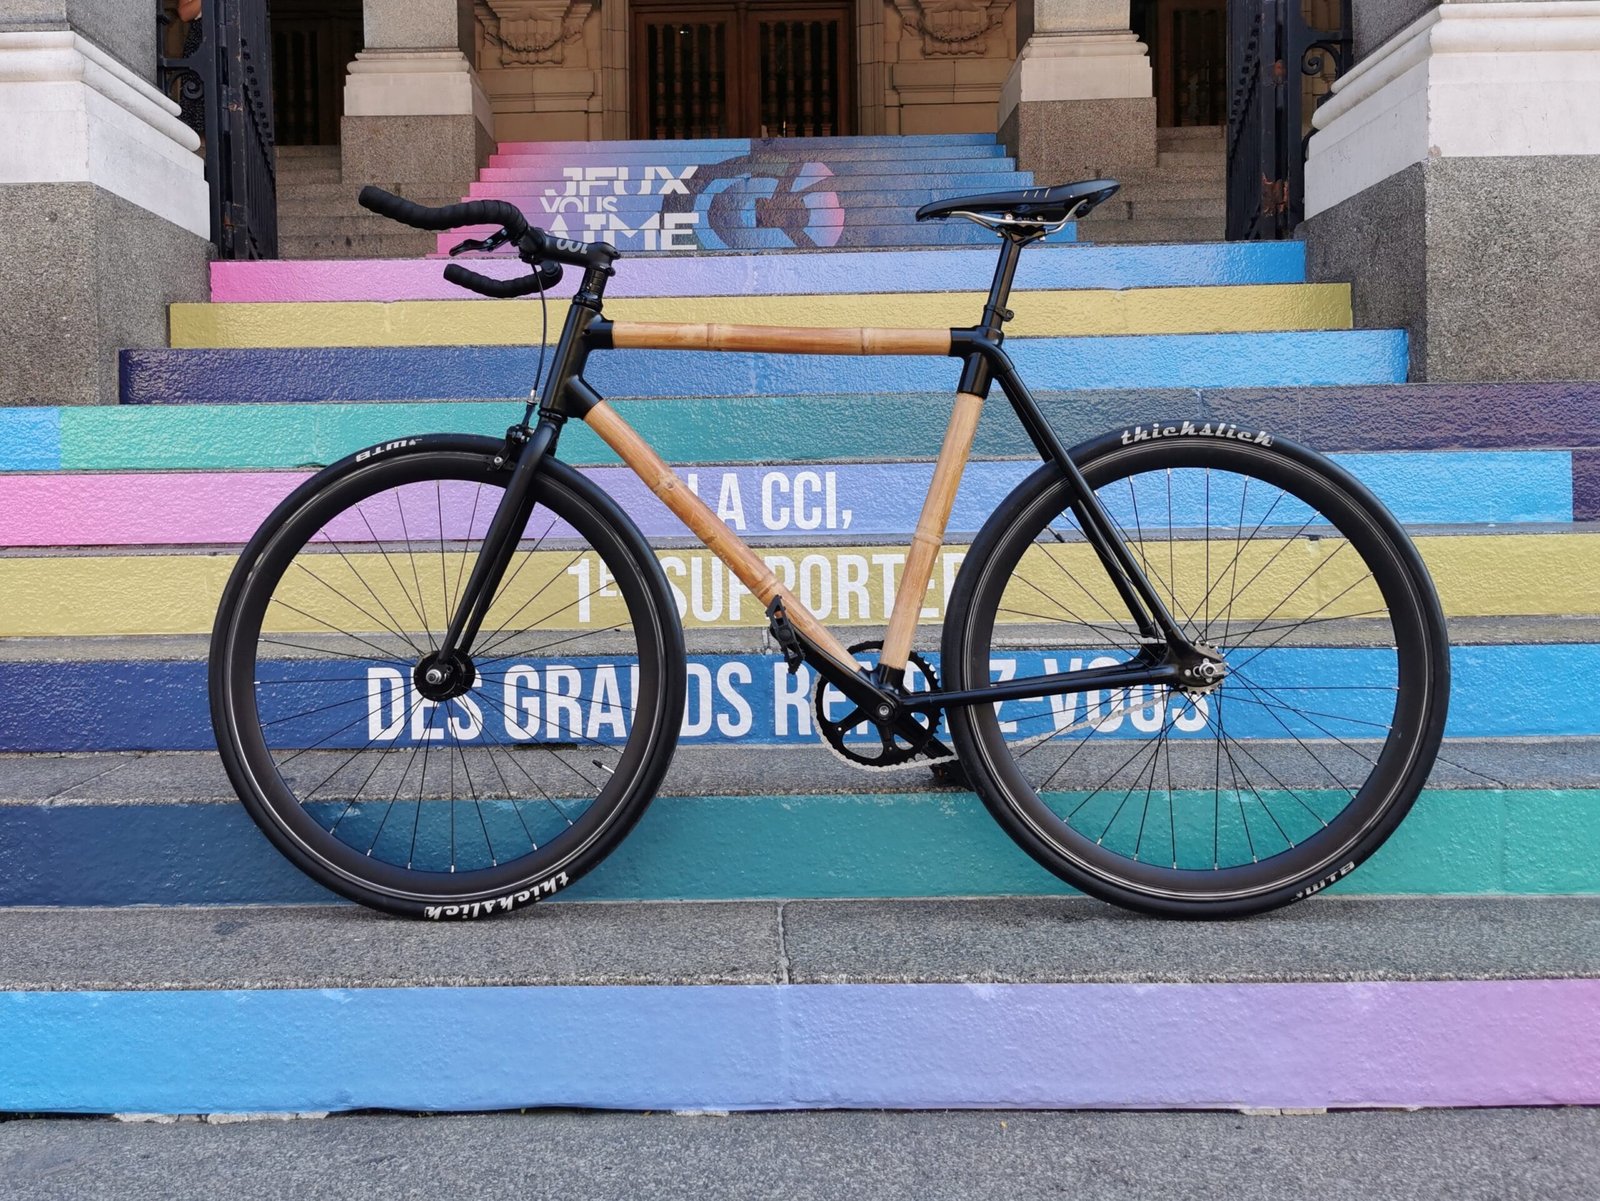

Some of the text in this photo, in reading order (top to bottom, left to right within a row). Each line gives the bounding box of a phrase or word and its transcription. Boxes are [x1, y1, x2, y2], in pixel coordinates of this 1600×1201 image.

[544, 165, 698, 196] JEUX
[539, 196, 618, 213] VOUS
[1121, 421, 1275, 447] thickslick
[355, 440, 408, 462] WTB
[761, 471, 853, 531] CCI,
[504, 661, 752, 740] GRADS
[424, 871, 569, 920] thickslick
